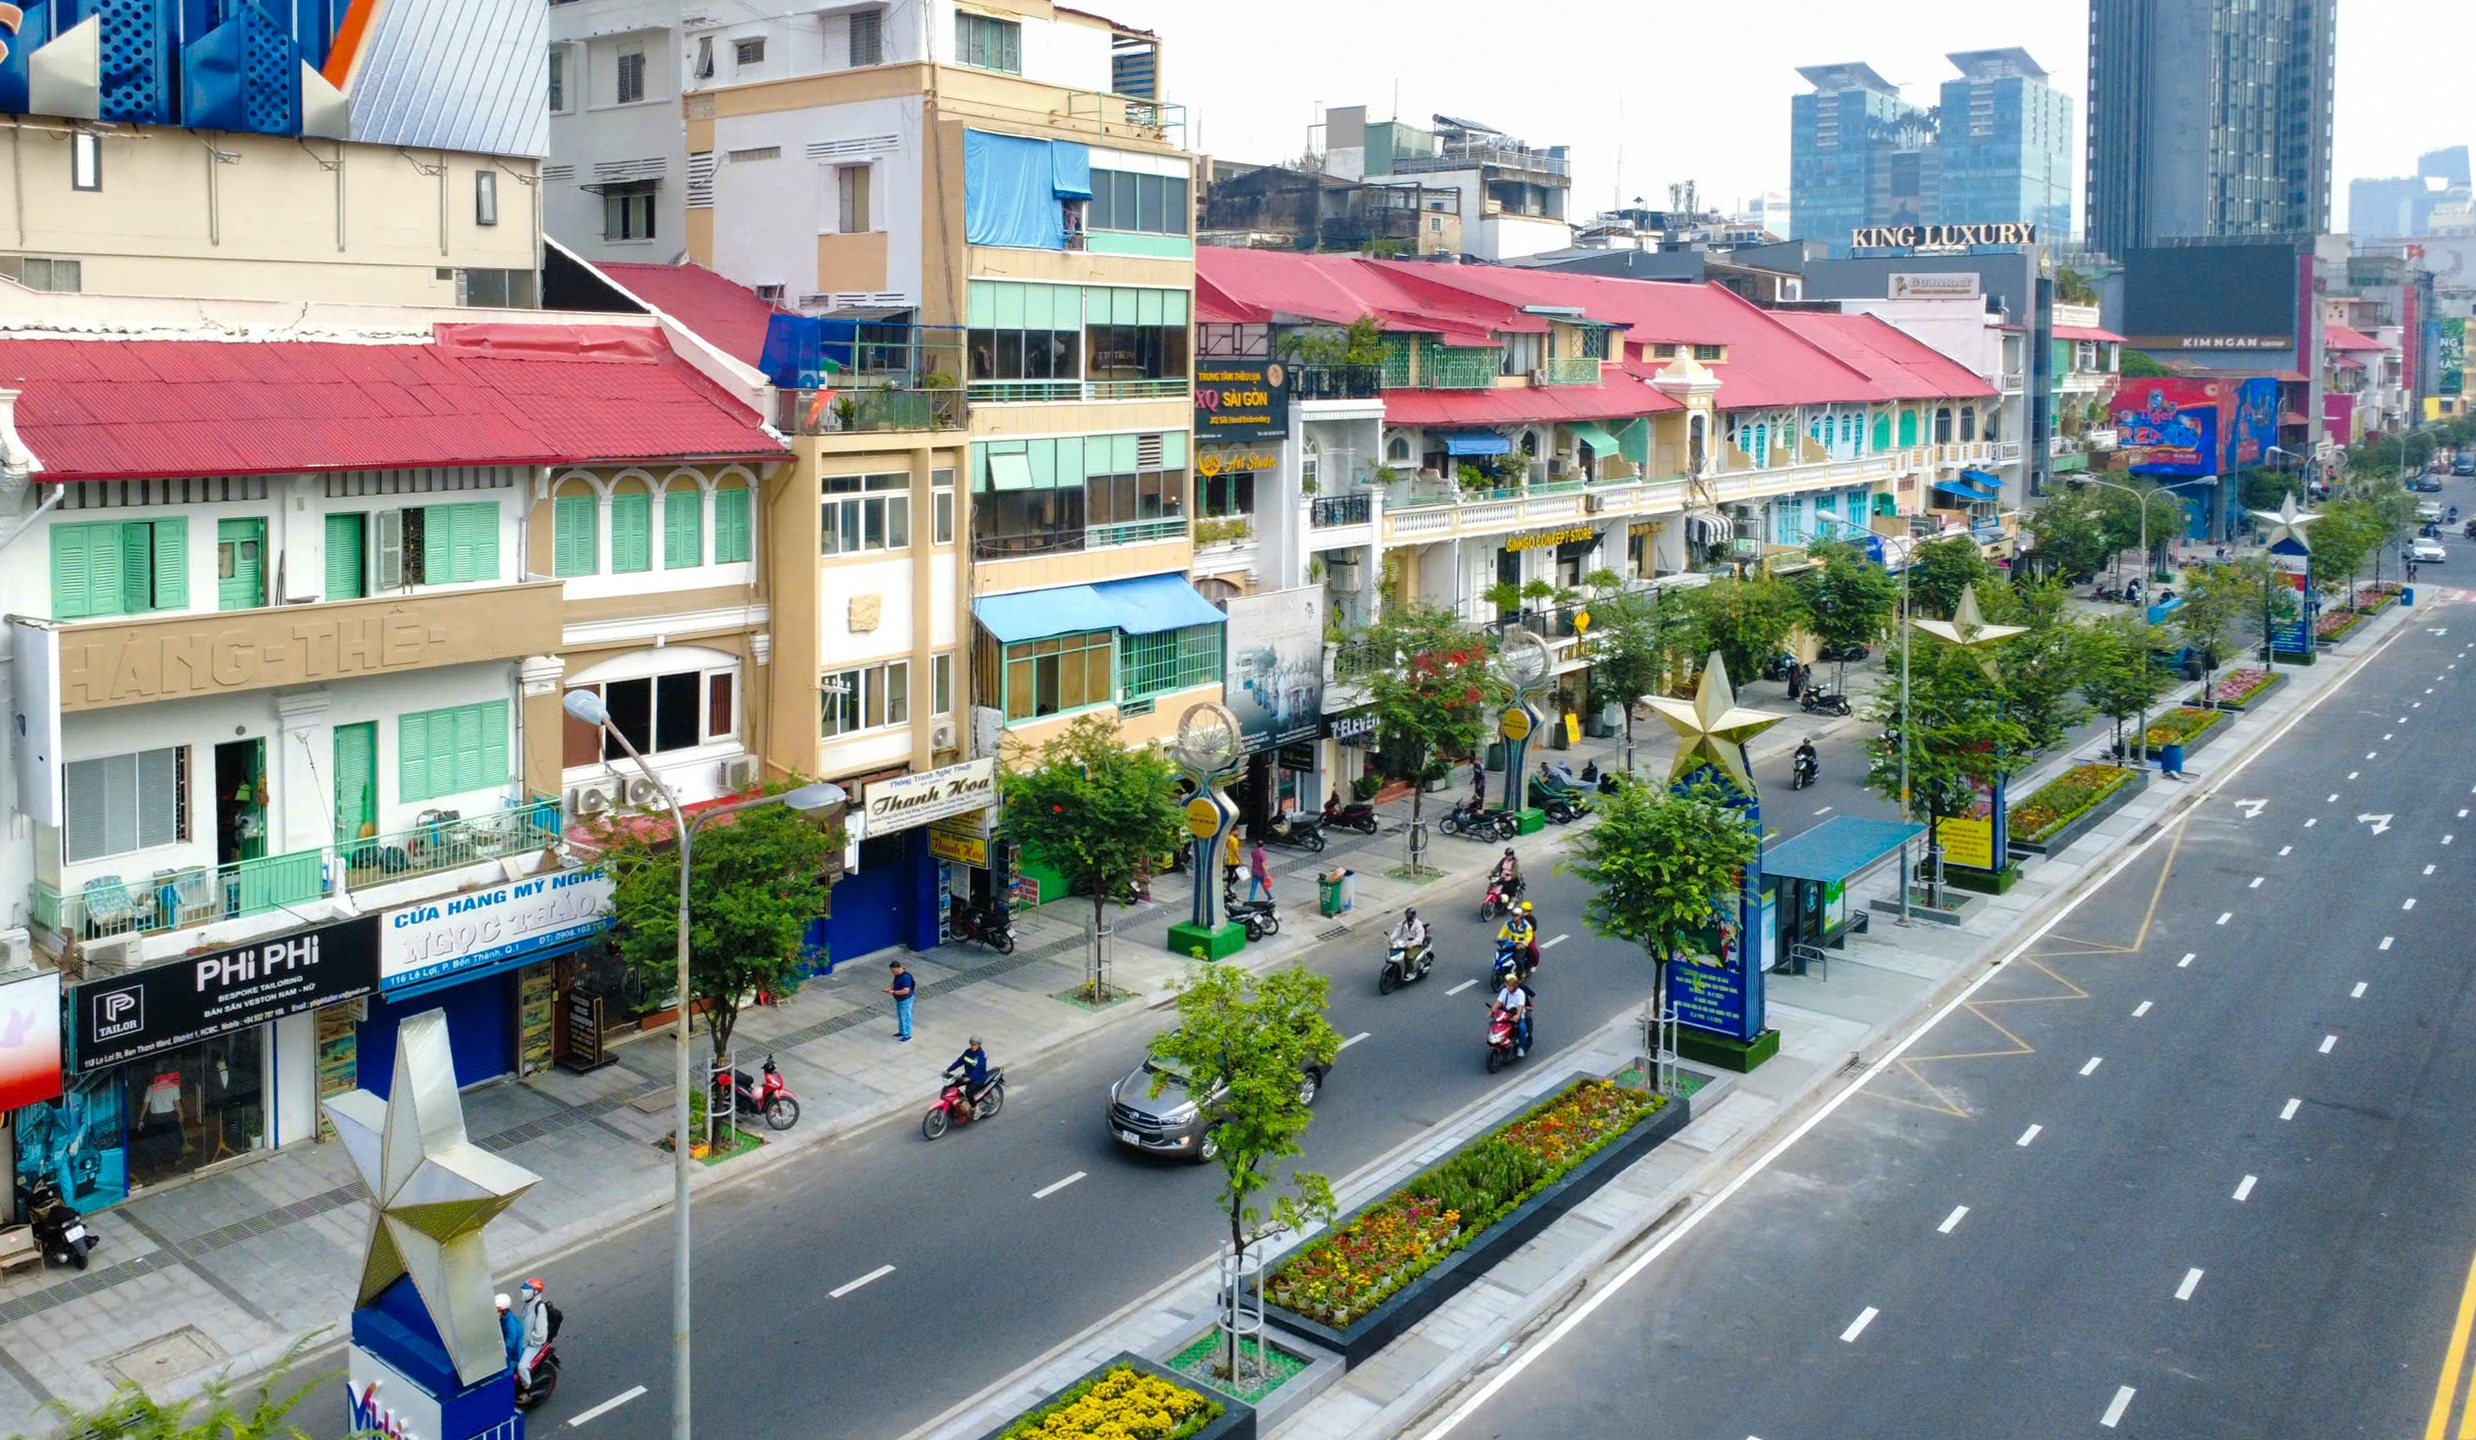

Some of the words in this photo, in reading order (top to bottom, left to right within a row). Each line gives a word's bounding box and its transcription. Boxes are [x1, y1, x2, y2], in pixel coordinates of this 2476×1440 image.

[1852, 226, 1916, 248] KING
[1924, 223, 2034, 246] LUXURY
[2182, 338, 2210, 346] KIM
[1198, 372, 1220, 381] TRUNG
[1195, 389, 1218, 412] XQ
[1247, 452, 1276, 470] Studio
[1506, 535, 1536, 552] GINKGO
[1536, 530, 1570, 548] CONCEPT
[1570, 528, 1592, 542] STORE
[872, 786, 940, 816] Thanh
[946, 778, 990, 796] Hoa
[394, 905, 440, 929] CỬA
[448, 890, 507, 916] HÀNG
[514, 878, 546, 899] MỸ
[402, 915, 501, 964] NGỌC
[538, 934, 553, 945] ĐT:
[390, 974, 406, 986] 116
[442, 962, 450, 972] P.
[505, 944, 520, 955] Q.1
[218, 986, 258, 1002] BESPOKE
[260, 975, 304, 994] TAILORING
[204, 1006, 222, 1018] BÁN
[244, 994, 278, 1008] VESTON
[278, 988, 297, 998] NAM
[99, 1019, 138, 1038] TAILOR
[104, 1054, 114, 1062] Loi
[124, 1047, 136, 1058] Ben
[137, 1042, 156, 1054] Thanh
[173, 1033, 194, 1044] District
